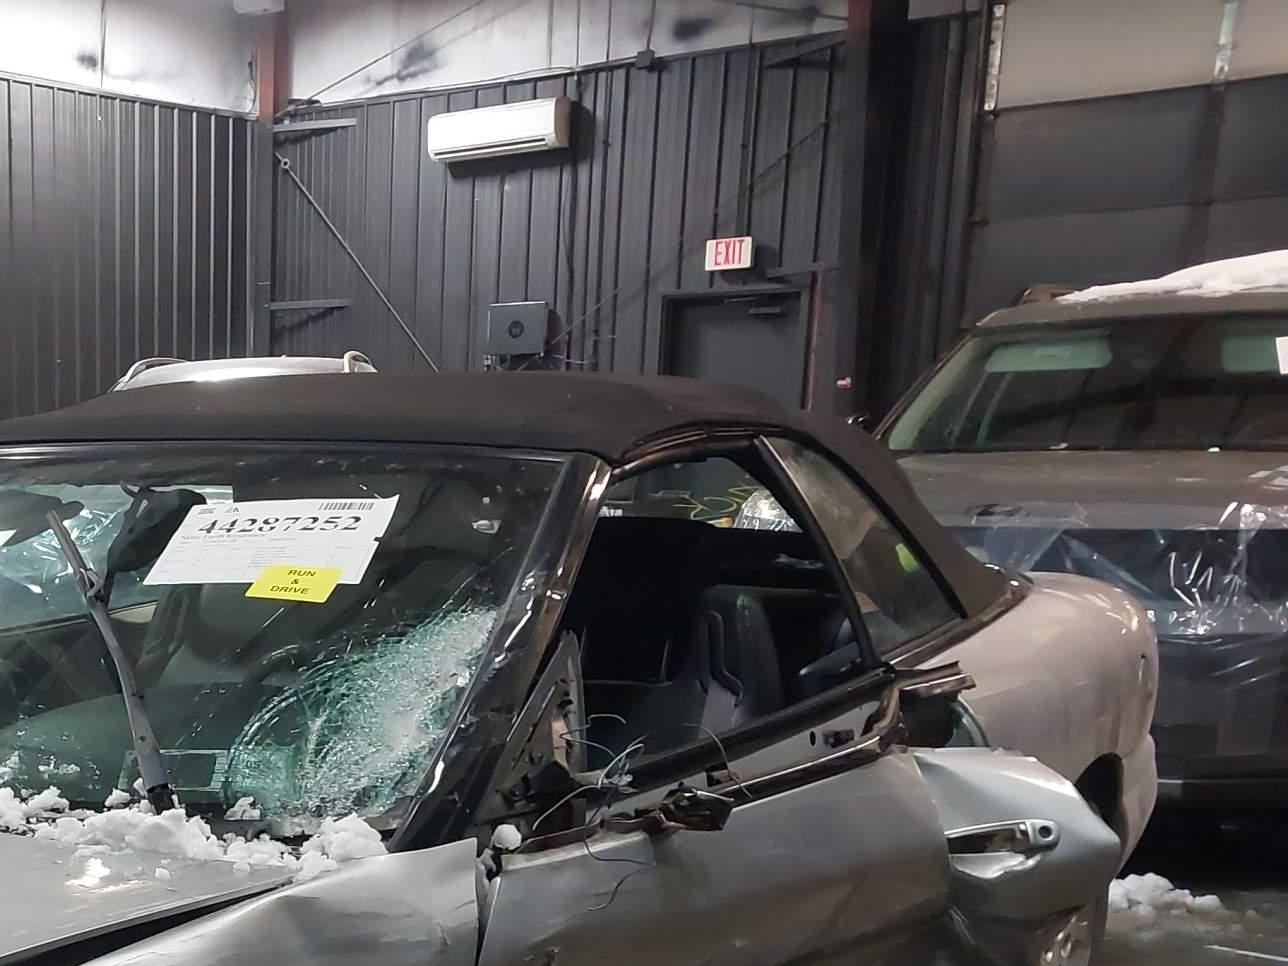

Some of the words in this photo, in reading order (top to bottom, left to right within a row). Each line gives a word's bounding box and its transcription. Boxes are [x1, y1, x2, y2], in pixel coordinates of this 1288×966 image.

[714, 239, 745, 266] EXIT
[197, 515, 362, 535] 44287252
[287, 569, 317, 577] RUN
[269, 585, 312, 595] DRIVE
